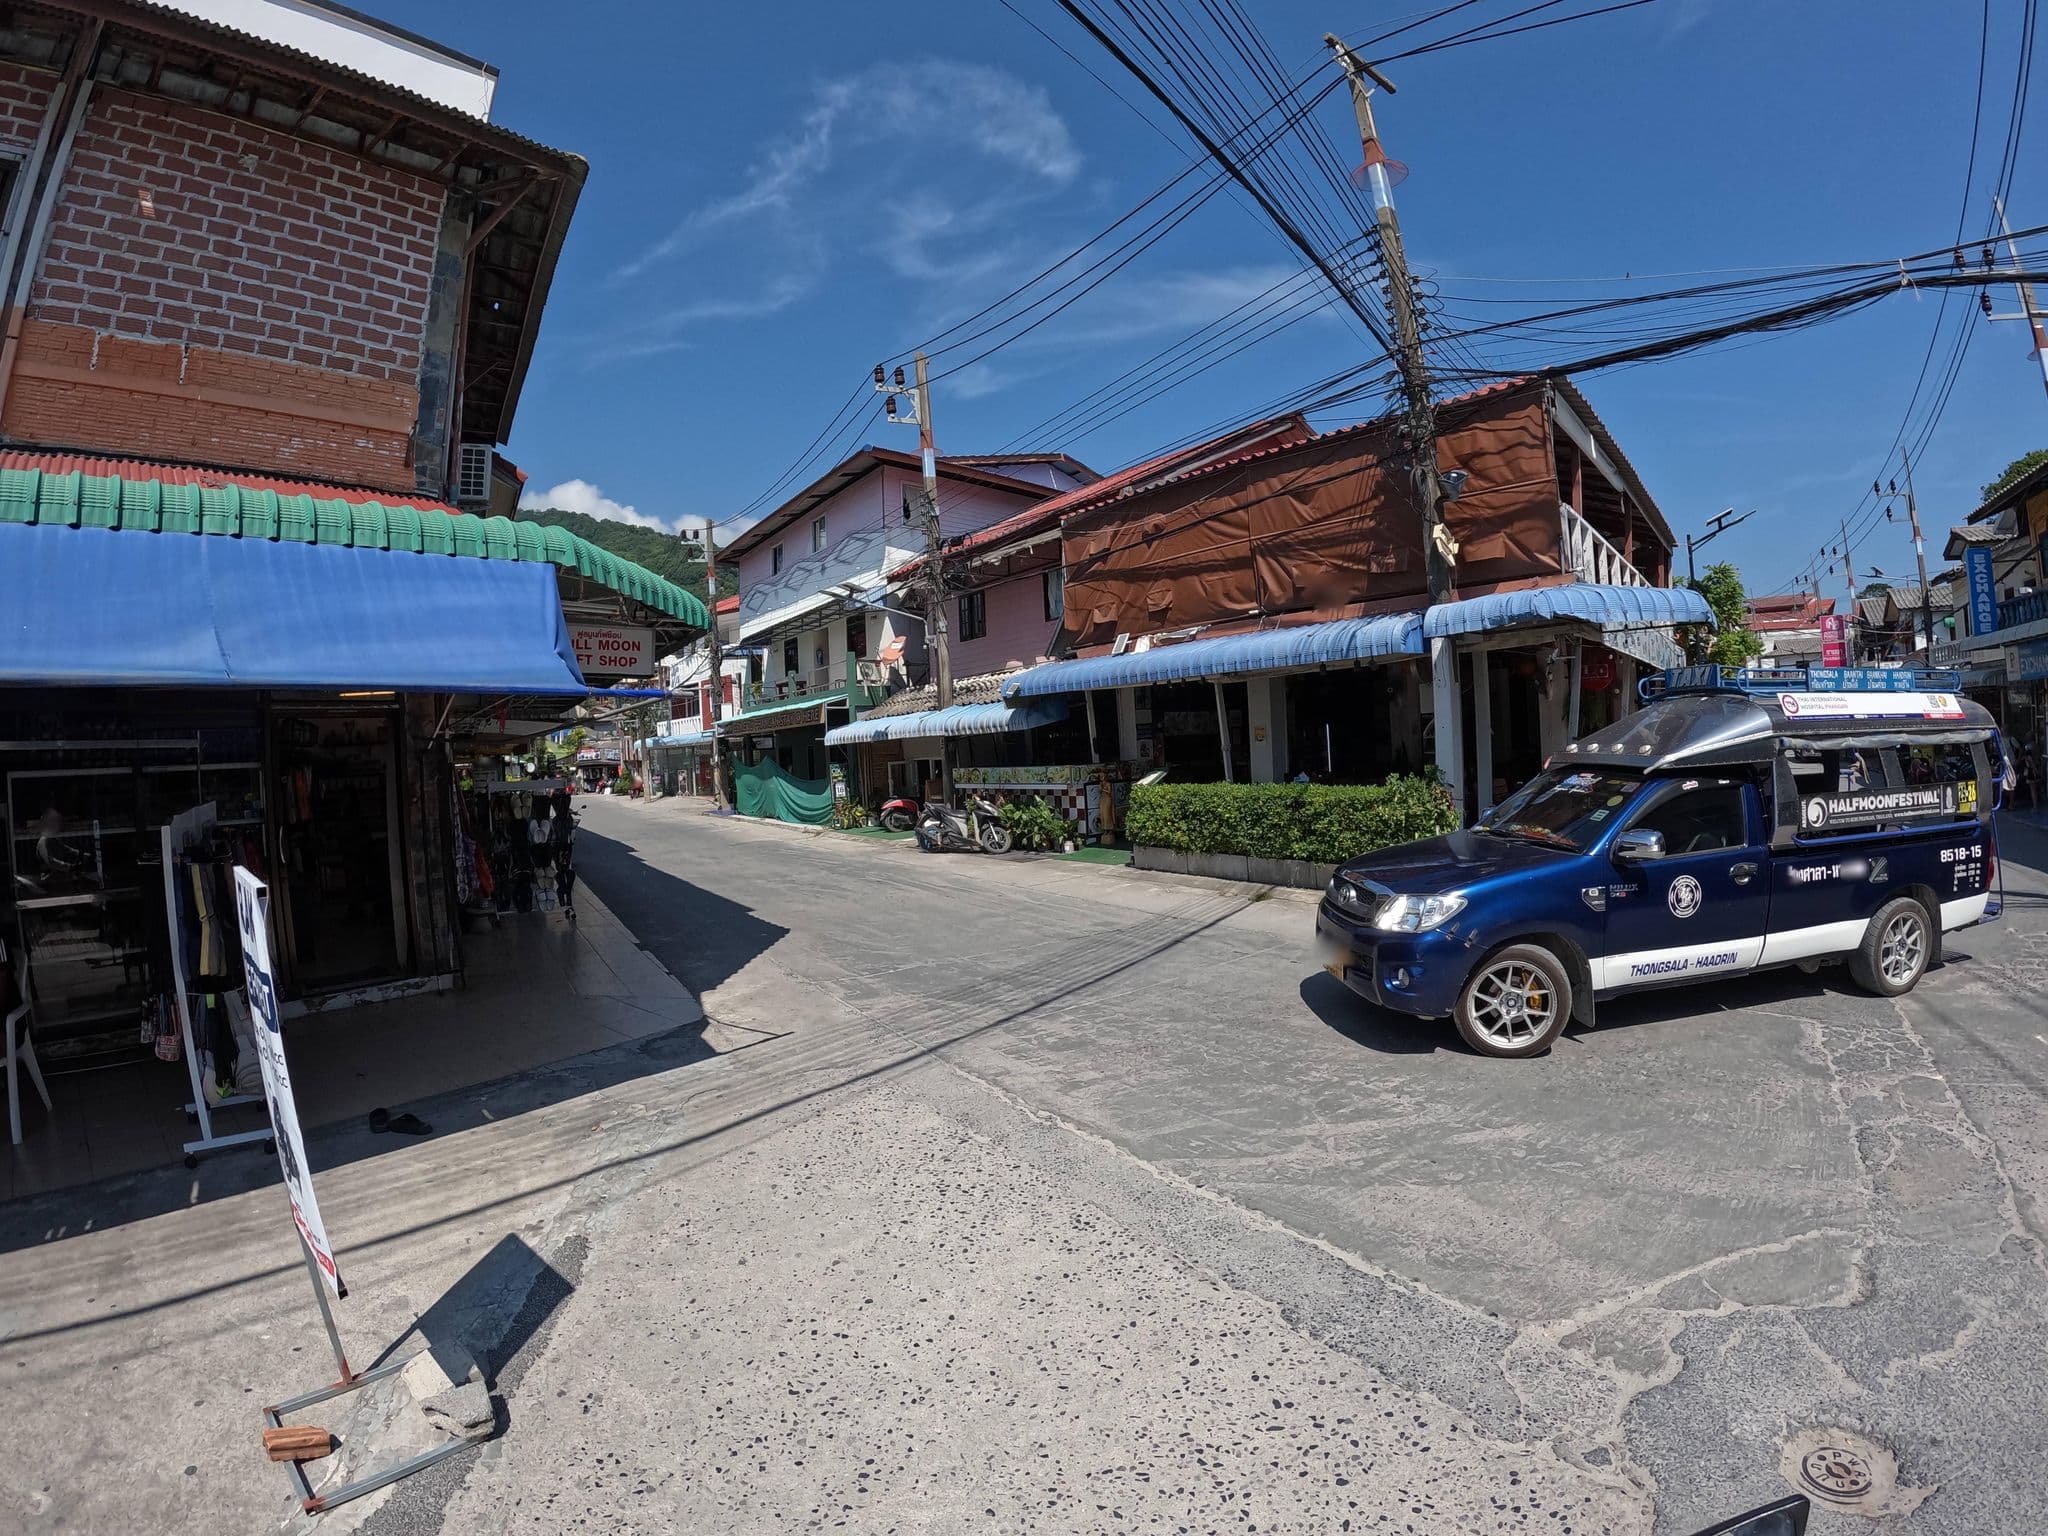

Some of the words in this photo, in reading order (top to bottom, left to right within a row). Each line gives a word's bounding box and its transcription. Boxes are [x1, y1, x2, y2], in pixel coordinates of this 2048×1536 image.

[1973, 553, 1992, 633] EXCHANGE
[572, 639, 592, 650] LL
[598, 640, 641, 652] MOON
[577, 653, 593, 665] FT
[599, 655, 638, 667] SHOP
[1671, 666, 1710, 687] TAXI
[1828, 791, 1940, 813] HALFMOONFESTIVAL
[1940, 845, 1982, 863] 8518-15
[1630, 958, 1689, 977] THONGSALA
[1695, 952, 1738, 969] HAADRIN
